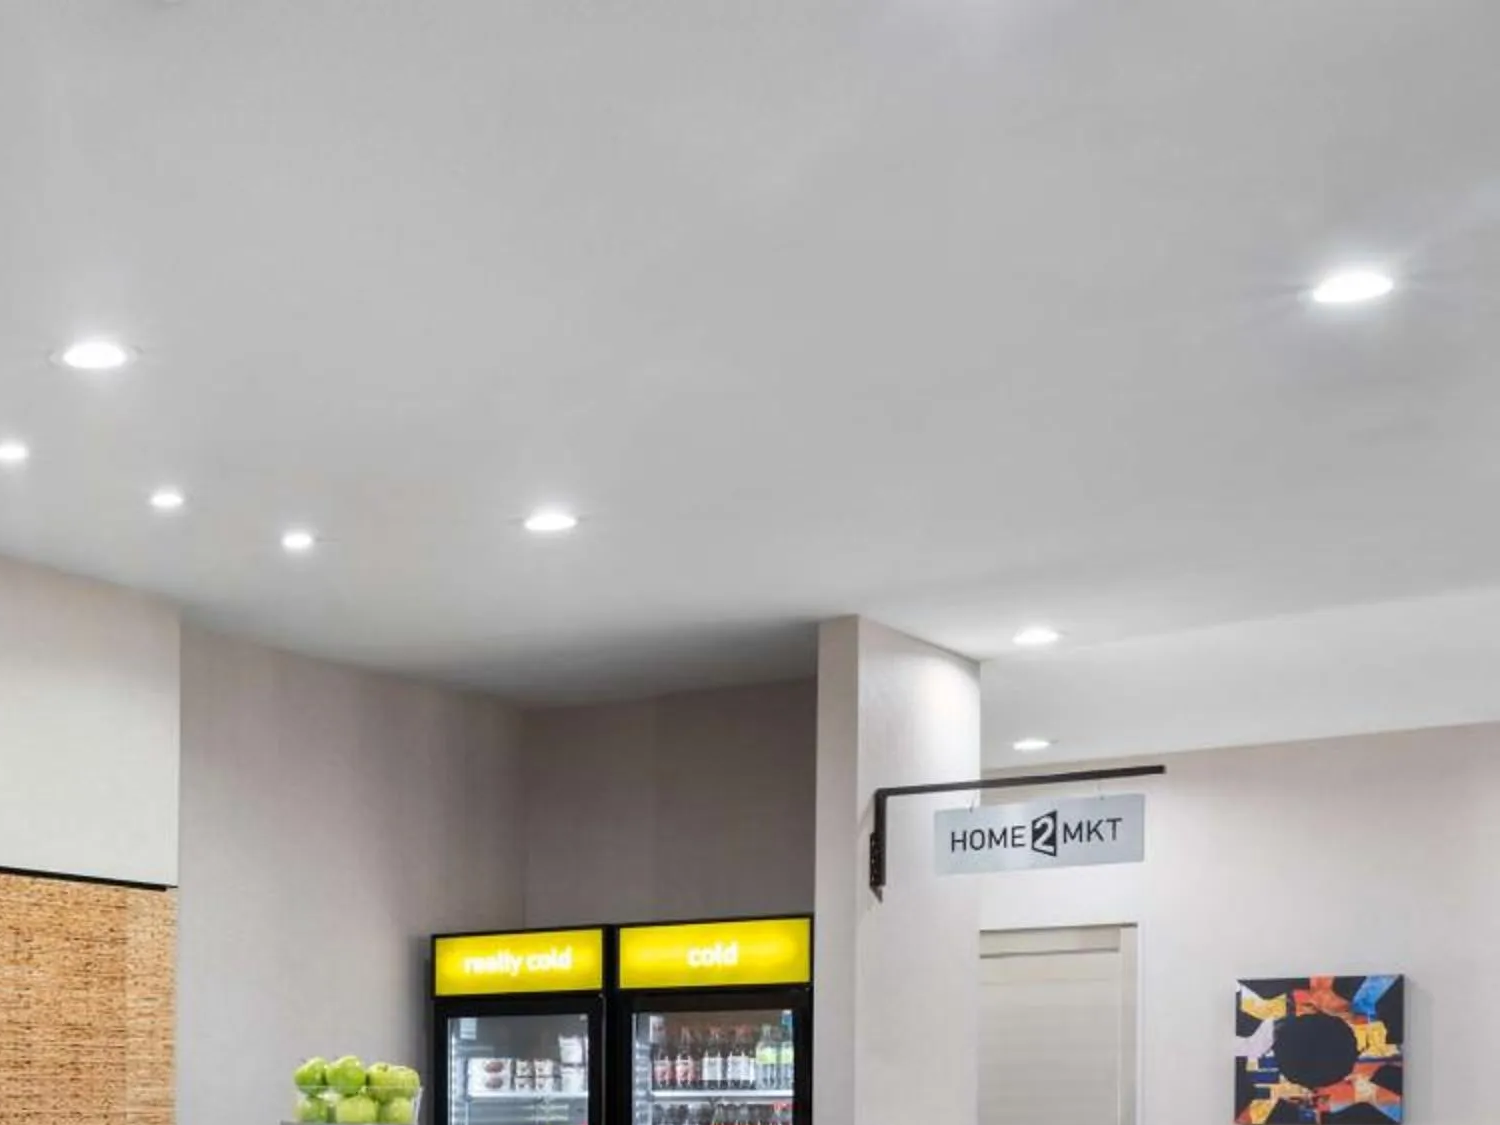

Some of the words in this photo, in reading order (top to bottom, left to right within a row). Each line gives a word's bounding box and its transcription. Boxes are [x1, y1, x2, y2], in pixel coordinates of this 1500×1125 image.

[463, 948, 520, 977] really
[526, 946, 573, 973] cold
[687, 941, 739, 968] cold
